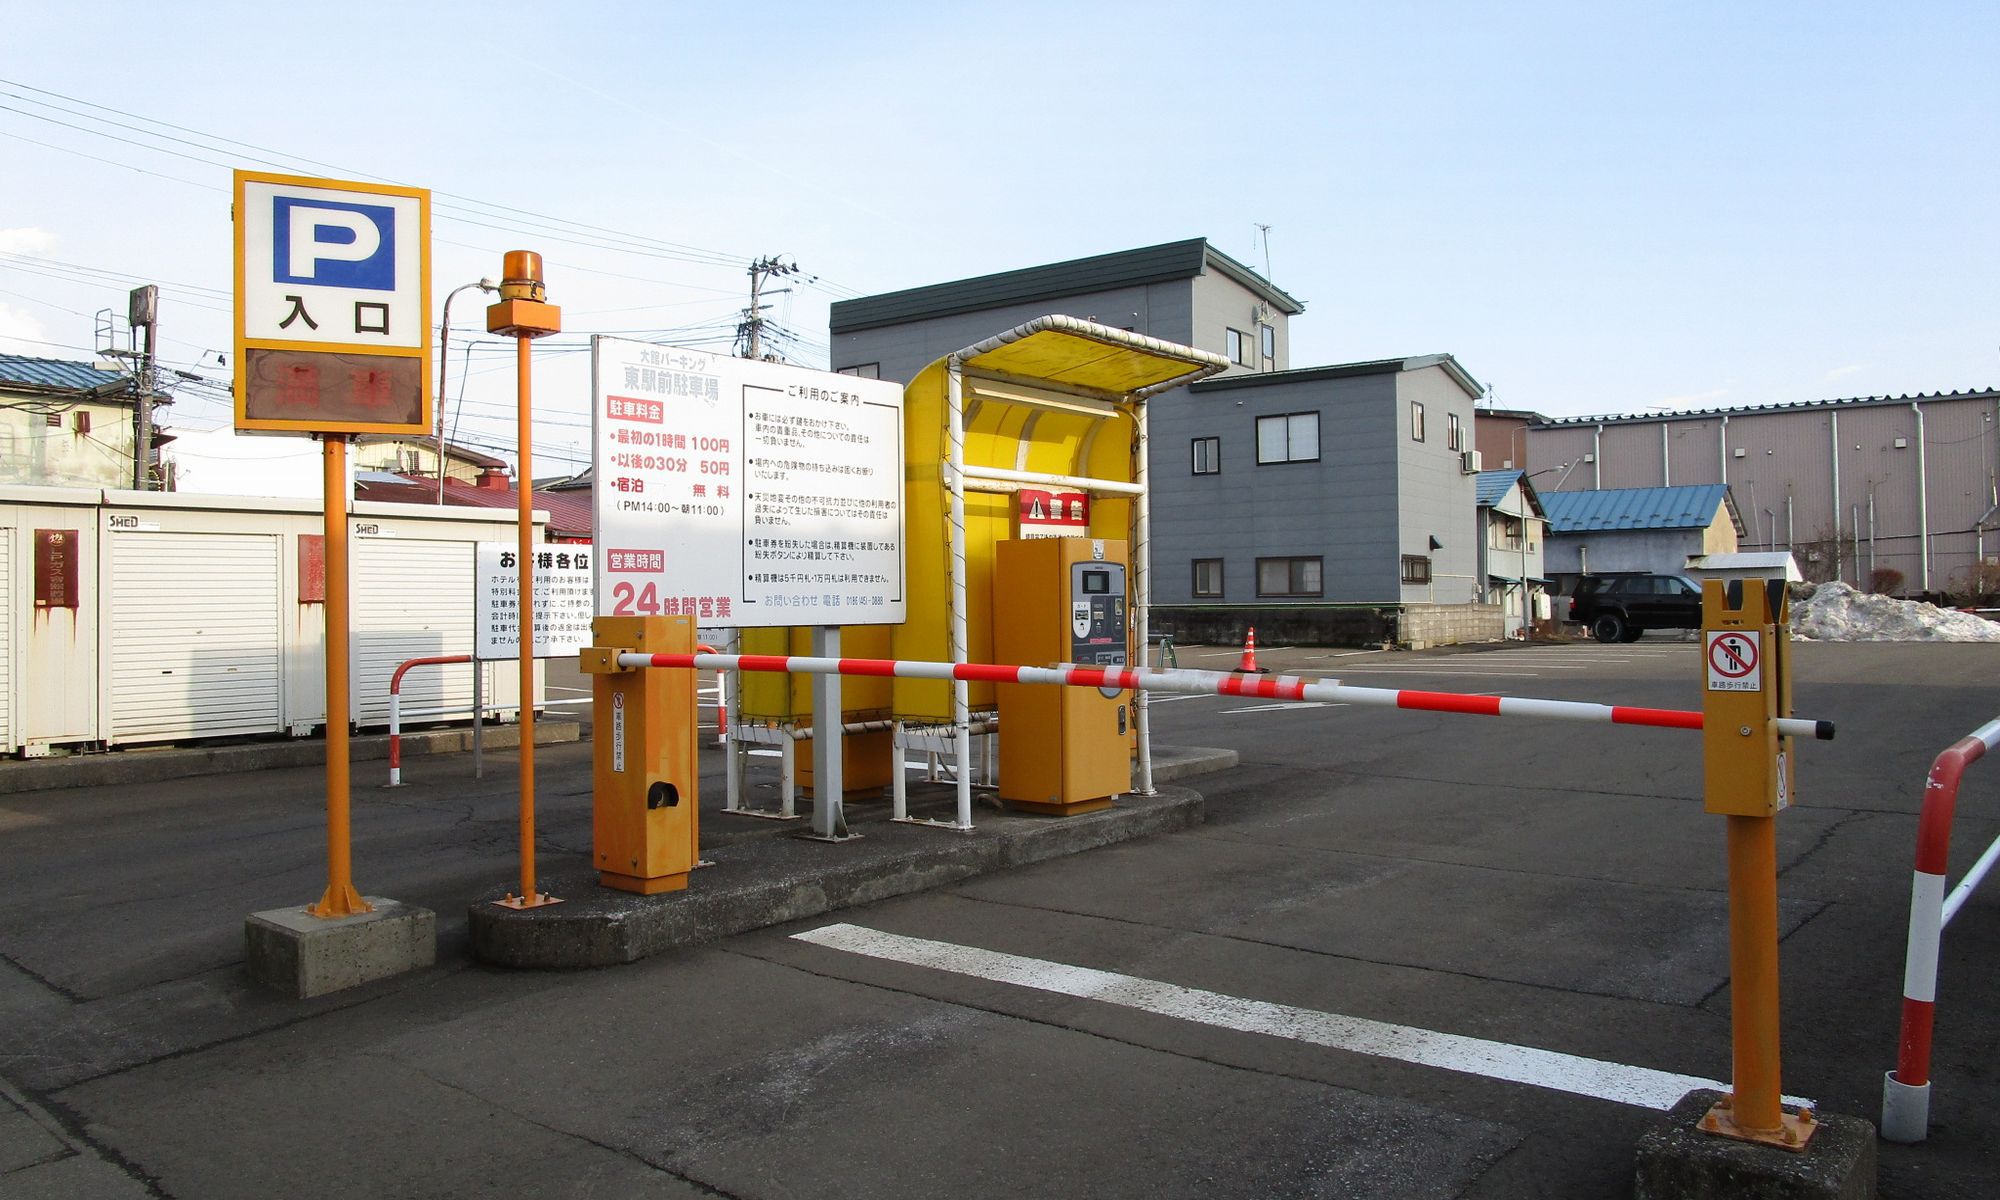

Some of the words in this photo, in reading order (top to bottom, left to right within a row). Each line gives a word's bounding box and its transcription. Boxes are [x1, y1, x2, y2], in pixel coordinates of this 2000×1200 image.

[289, 205, 381, 279] P
[279, 295, 389, 335] 入口
[640, 349, 706, 371] 大館パーキング
[624, 366, 719, 401] 東駅前駐車場
[788, 385, 860, 407] ご利用のご案内
[609, 399, 661, 420] 駐車料金
[617, 428, 686, 449] 最初の1時間
[691, 436, 730, 453] 100円
[617, 453, 688, 473] 以後の30分
[700, 460, 730, 476] 50円
[755, 470, 789, 481] いたします。
[617, 477, 644, 493] 宿泊
[110, 515, 138, 528] SHED
[356, 523, 379, 535] SHED
[755, 516, 791, 526] 負いません。
[500, 551, 589, 570] お様各位
[611, 552, 661, 570] 営業時間
[491, 575, 589, 584] ホテル利用のお客様は
[491, 599, 593, 608] 駐車券れずに、ご持参の、
[612, 581, 732, 618] 24時間営業
[764, 595, 818, 607] お問い合わせ
[823, 594, 841, 607] 電話
[491, 611, 591, 620] 会計時提示下さい。但し
[1711, 681, 1758, 690] 車路歩行禁止
